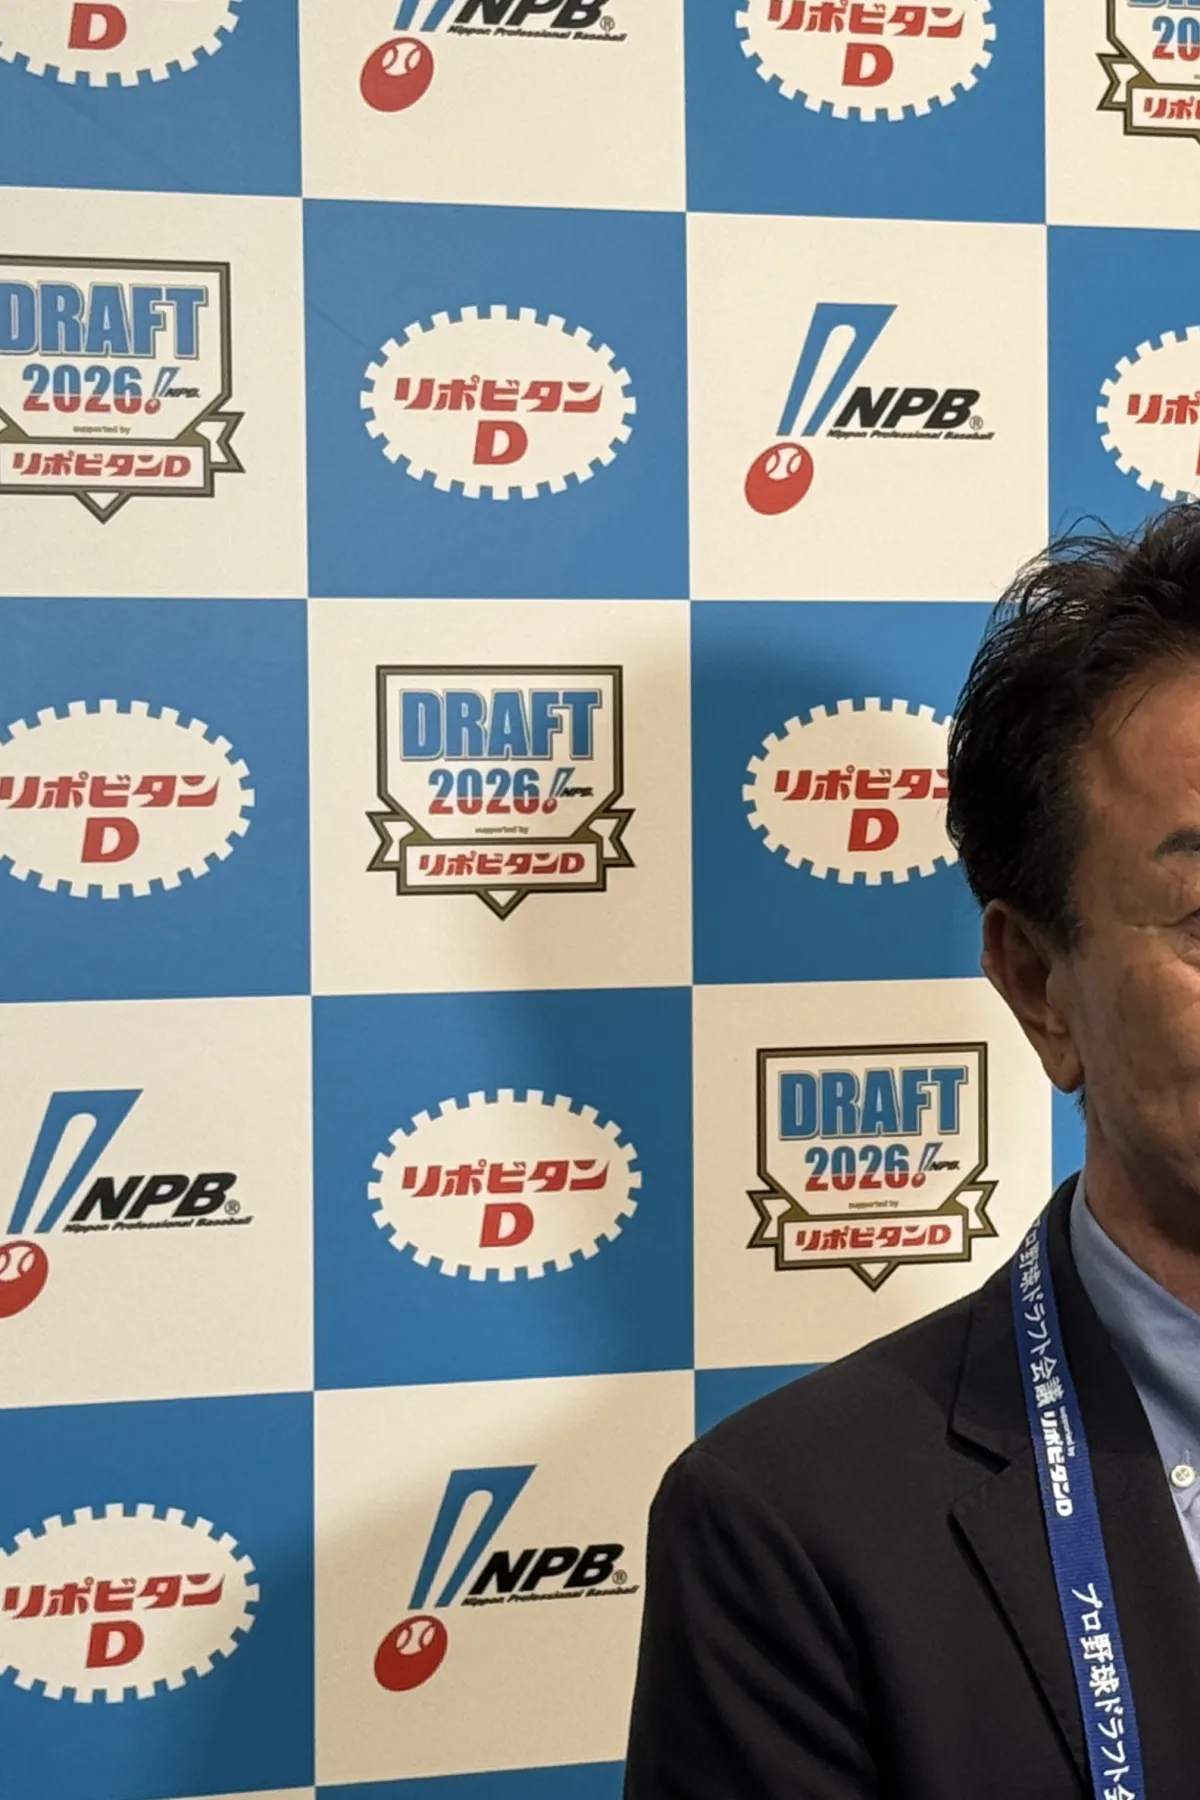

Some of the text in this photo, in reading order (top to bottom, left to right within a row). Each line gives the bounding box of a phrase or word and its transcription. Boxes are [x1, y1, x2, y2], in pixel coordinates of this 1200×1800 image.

[68, 2, 127, 50] D
[767, 0, 966, 38] リポビタン
[841, 42, 894, 87] D
[0, 280, 209, 360] DRAFT
[394, 375, 604, 414] リポビタン
[12, 450, 191, 478] リポビタンD
[473, 419, 529, 466] D
[399, 688, 603, 762] DRAFT
[0, 770, 220, 809] リポビタン
[81, 816, 140, 863] D
[847, 808, 900, 852] D
[418, 850, 585, 877] リポビタンD
[778, 1065, 969, 1141] DRAFT
[402, 1158, 610, 1199] リポビタン
[479, 1201, 535, 1248] D
[795, 1224, 952, 1252] リポビタンD
[2, 1574, 225, 1619] リポビタン
[85, 1620, 145, 1669] D
